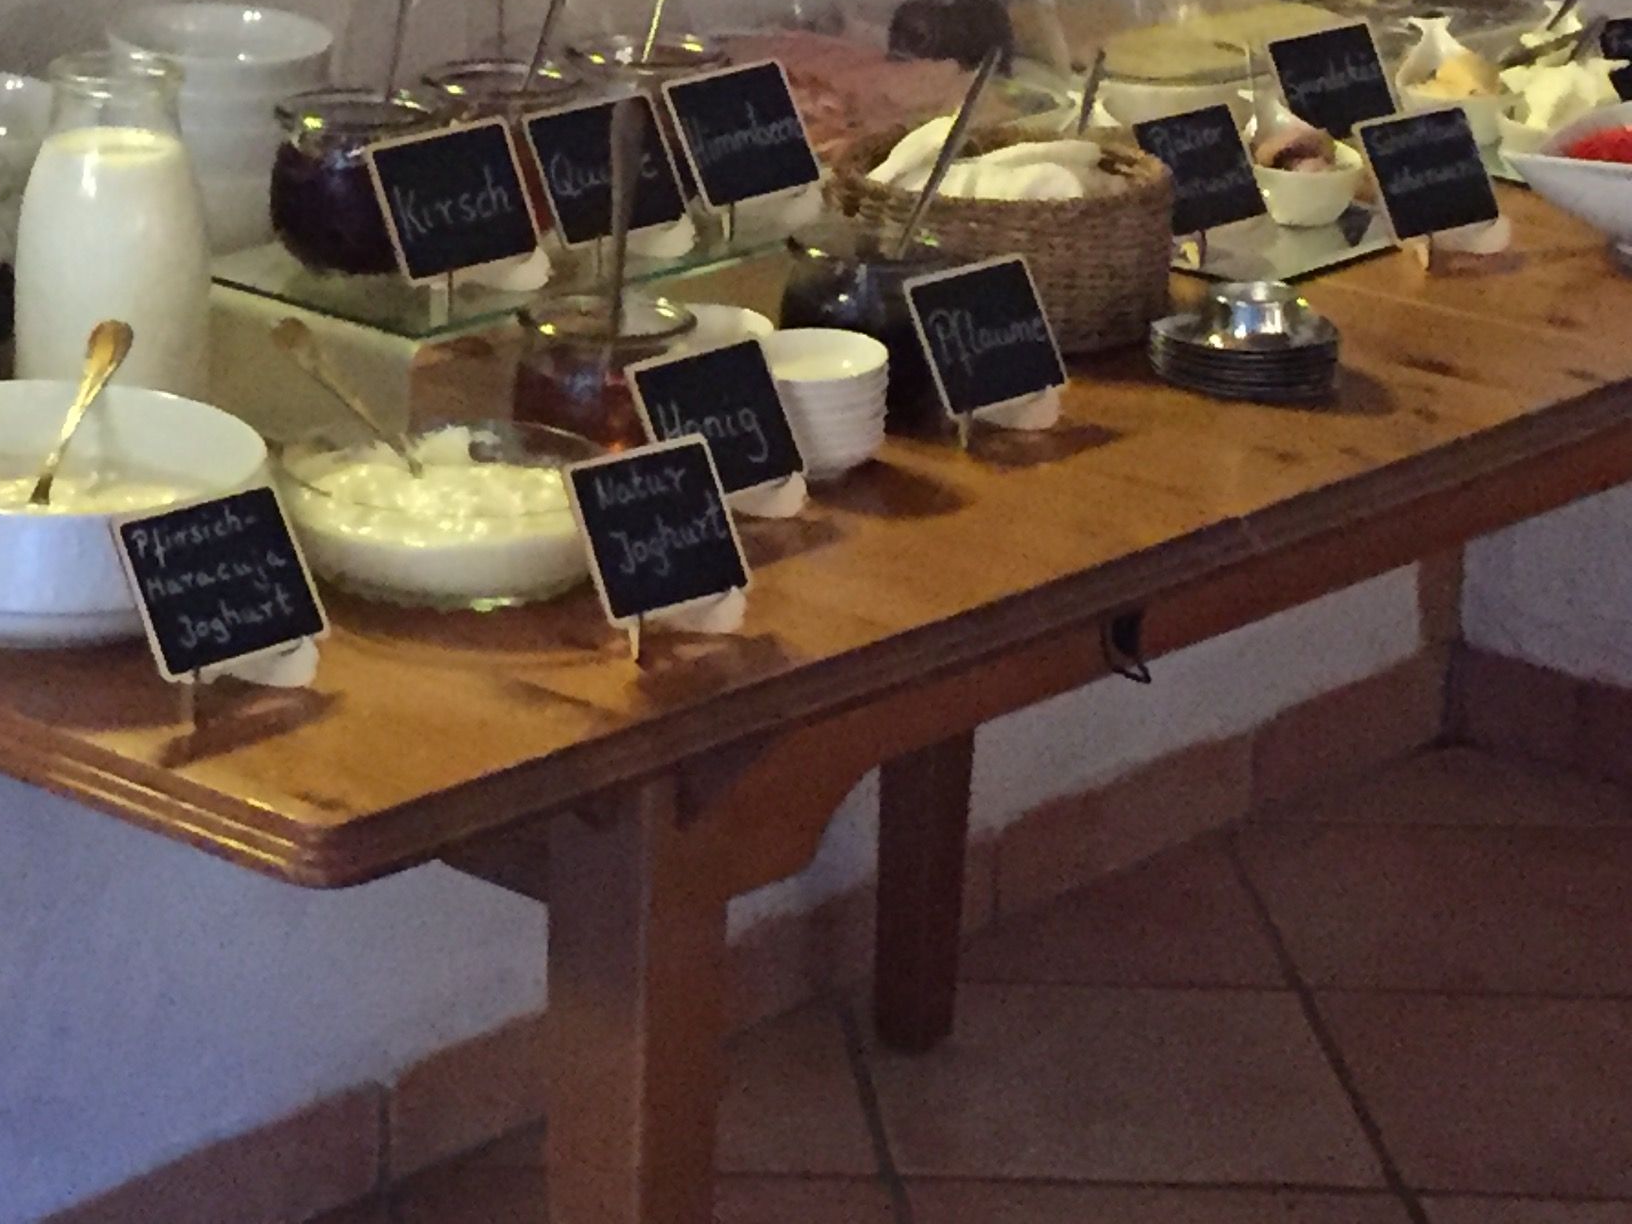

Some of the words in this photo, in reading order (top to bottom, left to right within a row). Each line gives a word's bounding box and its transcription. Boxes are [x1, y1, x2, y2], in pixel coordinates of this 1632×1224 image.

[393, 165, 512, 241] Kirsch
[928, 308, 1045, 375] Pflaume
[655, 399, 769, 463] Honig
[594, 466, 687, 510] Natur
[608, 489, 728, 576] Joghurt
[177, 582, 294, 649] Joghurt
